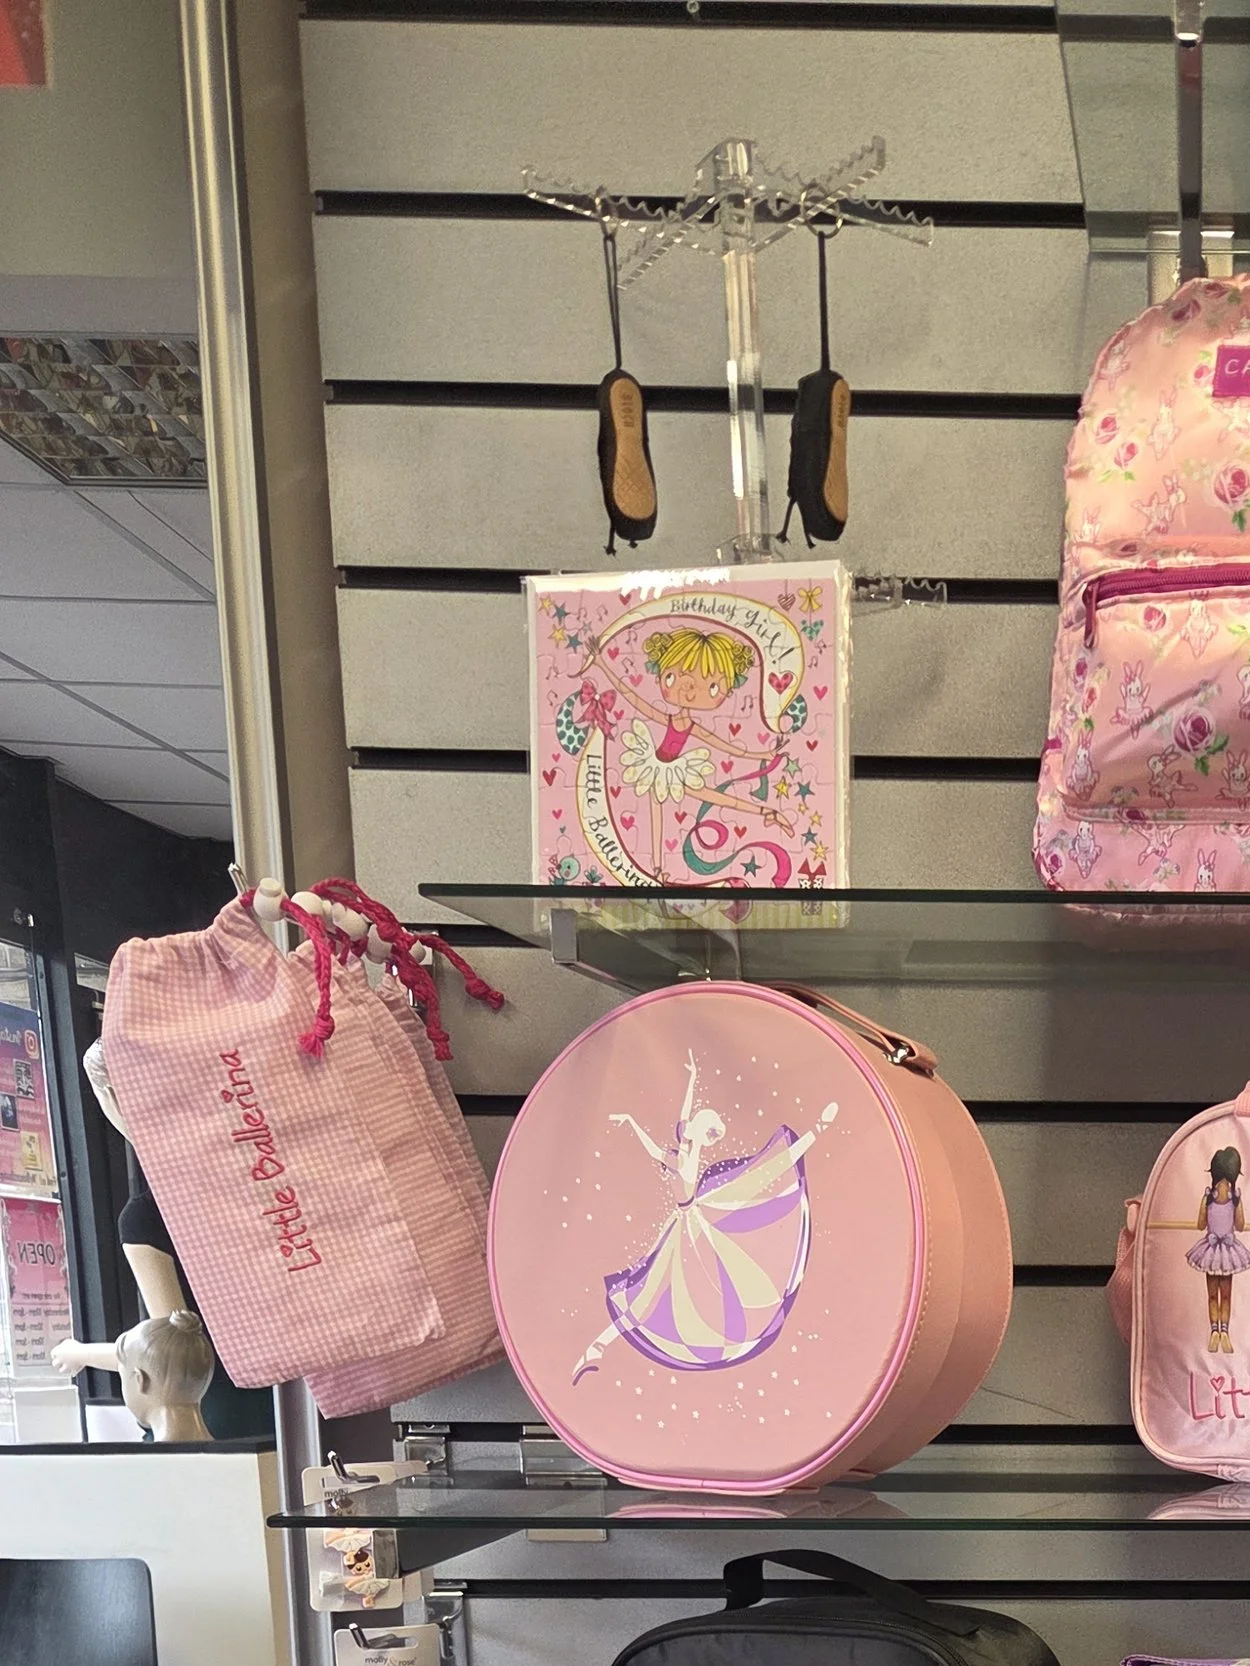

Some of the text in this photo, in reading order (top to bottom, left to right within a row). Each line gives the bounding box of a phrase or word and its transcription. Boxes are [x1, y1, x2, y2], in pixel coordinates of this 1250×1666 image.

[670, 597, 737, 621] Birthday
[586, 754, 602, 809] Little
[219, 1048, 322, 1272] Little Ballerina
[365, 1655, 388, 1665] molly
